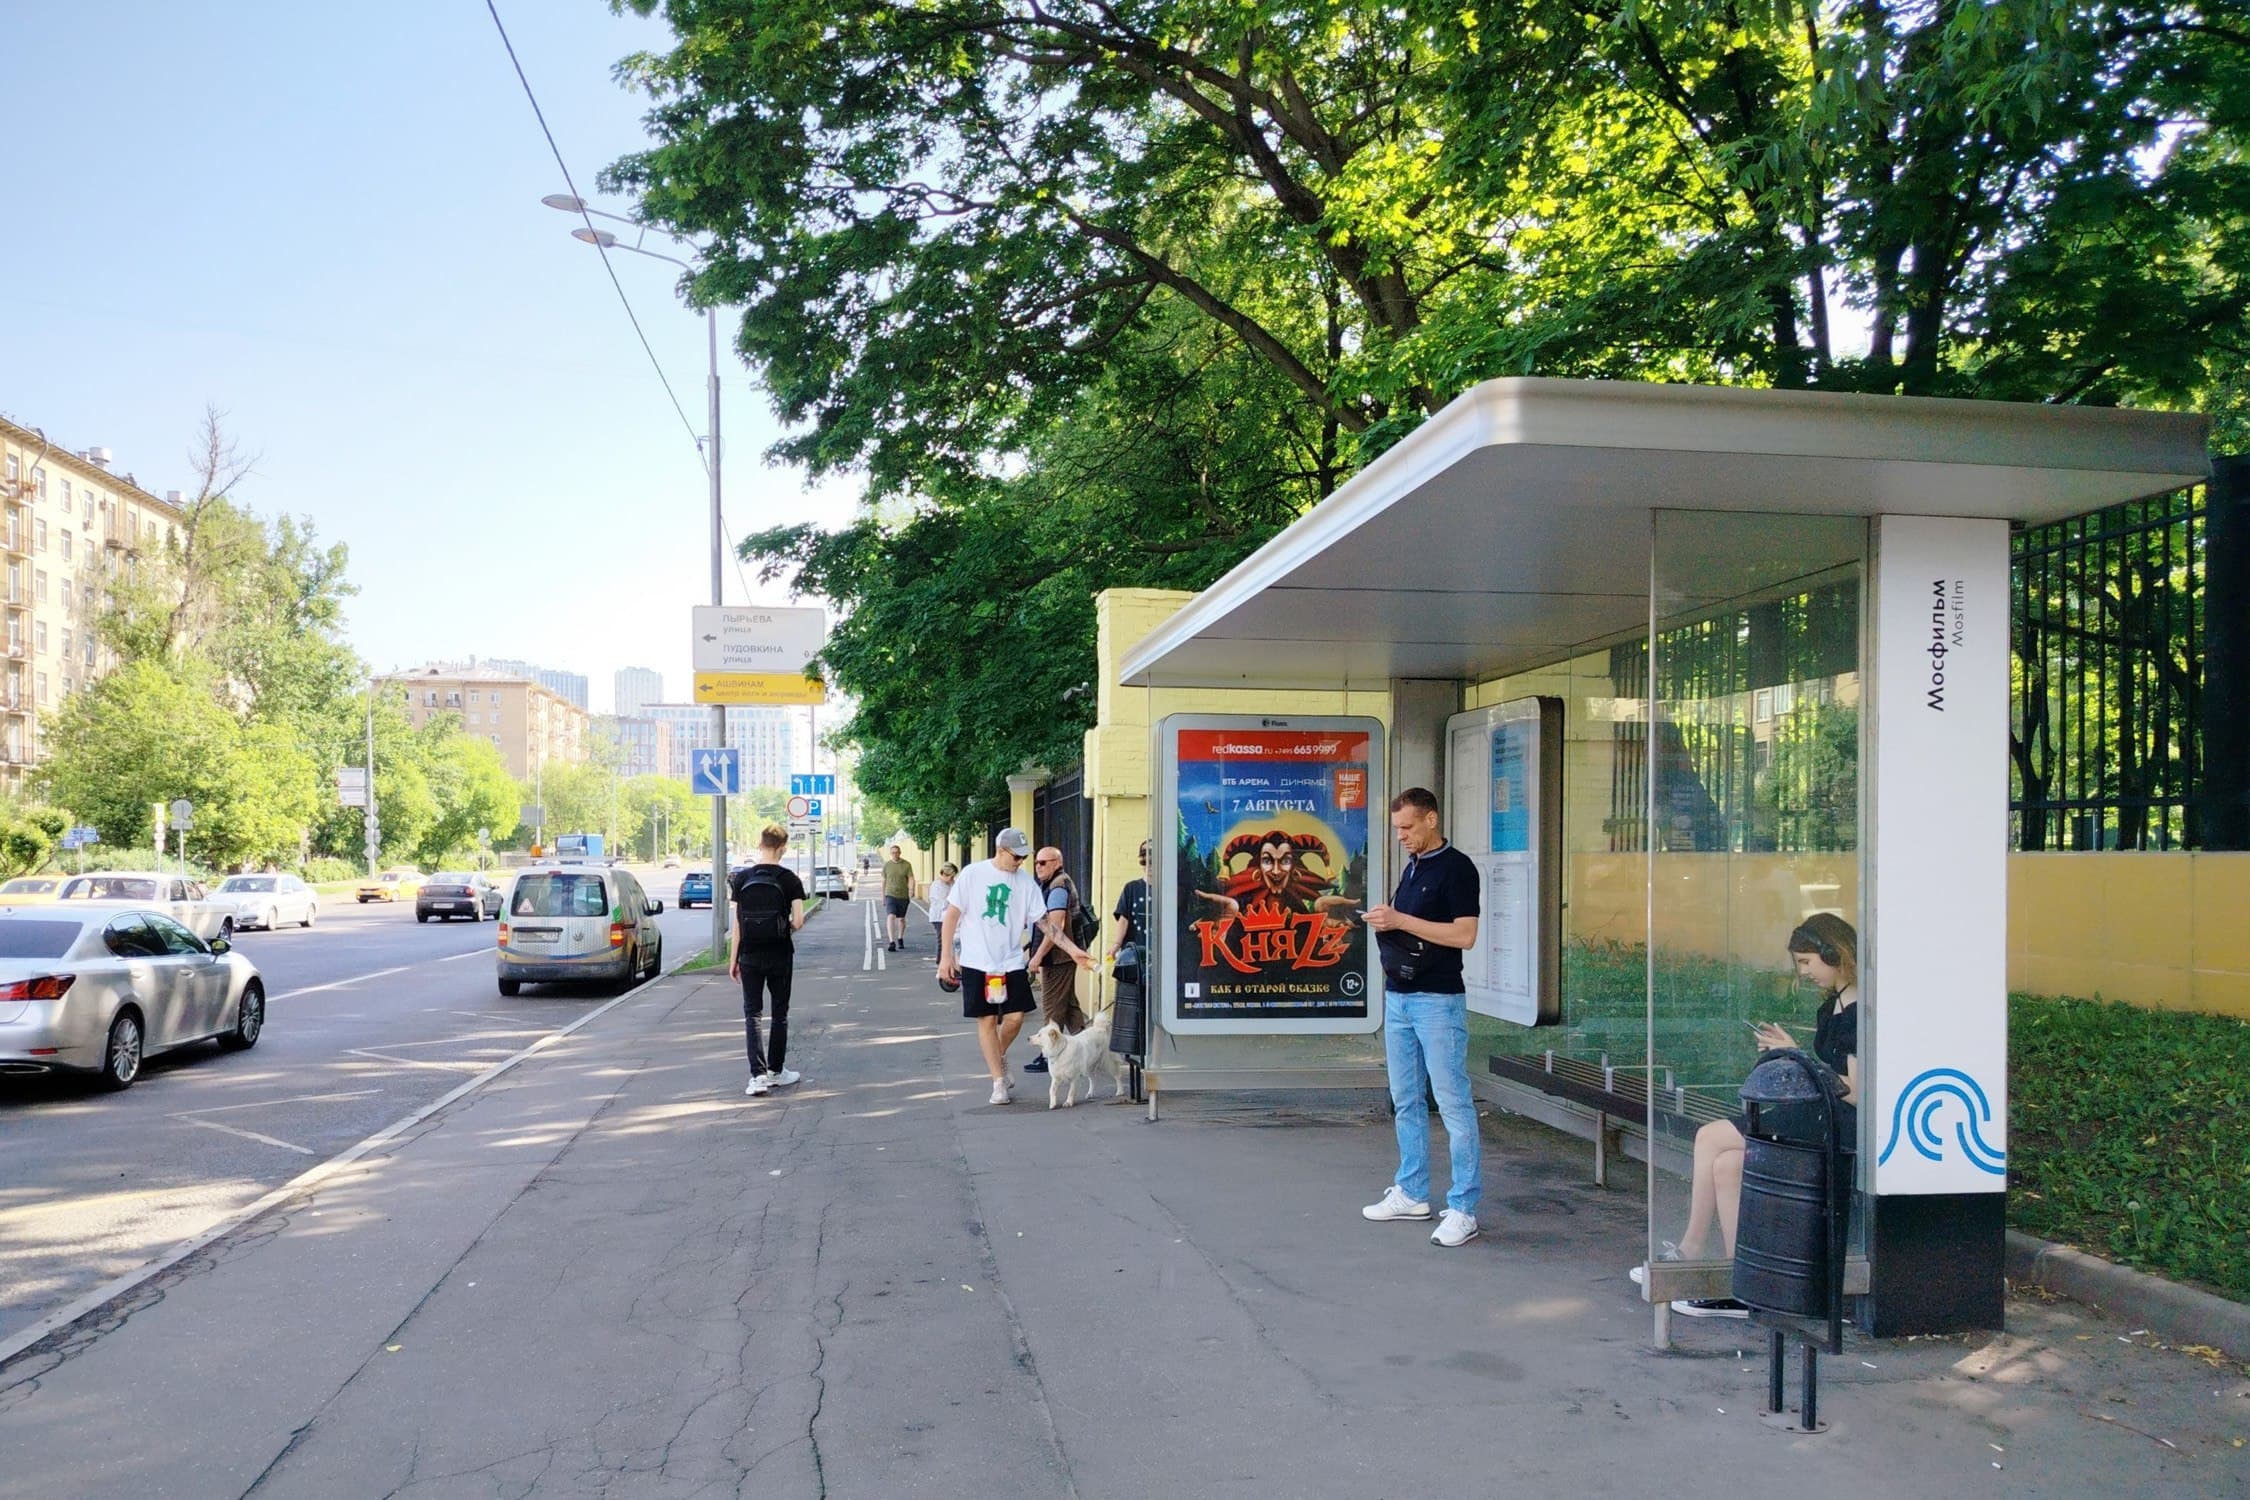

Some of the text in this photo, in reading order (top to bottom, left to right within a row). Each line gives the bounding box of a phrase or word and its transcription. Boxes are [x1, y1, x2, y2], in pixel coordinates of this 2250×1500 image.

[722, 614, 773, 624] ПЫРЬЕВА
[1952, 580, 1964, 647] Mosfilm
[722, 626, 752, 635] улица
[722, 644, 784, 654] ПУДОВКИНА
[1927, 579, 1948, 712] Мосфильм
[722, 656, 752, 665] улица
[716, 679, 765, 688] АШВИНАМ
[1212, 743, 1273, 755] redkassa.ru
[1222, 778, 1270, 786] ВТБ АРЕНА
[1280, 778, 1327, 786] ДИНАМО
[809, 800, 819, 814] P
[1232, 799, 1316, 813] 7 АВГУСТА
[1210, 982, 1330, 994] КАК В СТАРОЙ СКАЗКЕ
[1345, 978, 1360, 990] 12+
